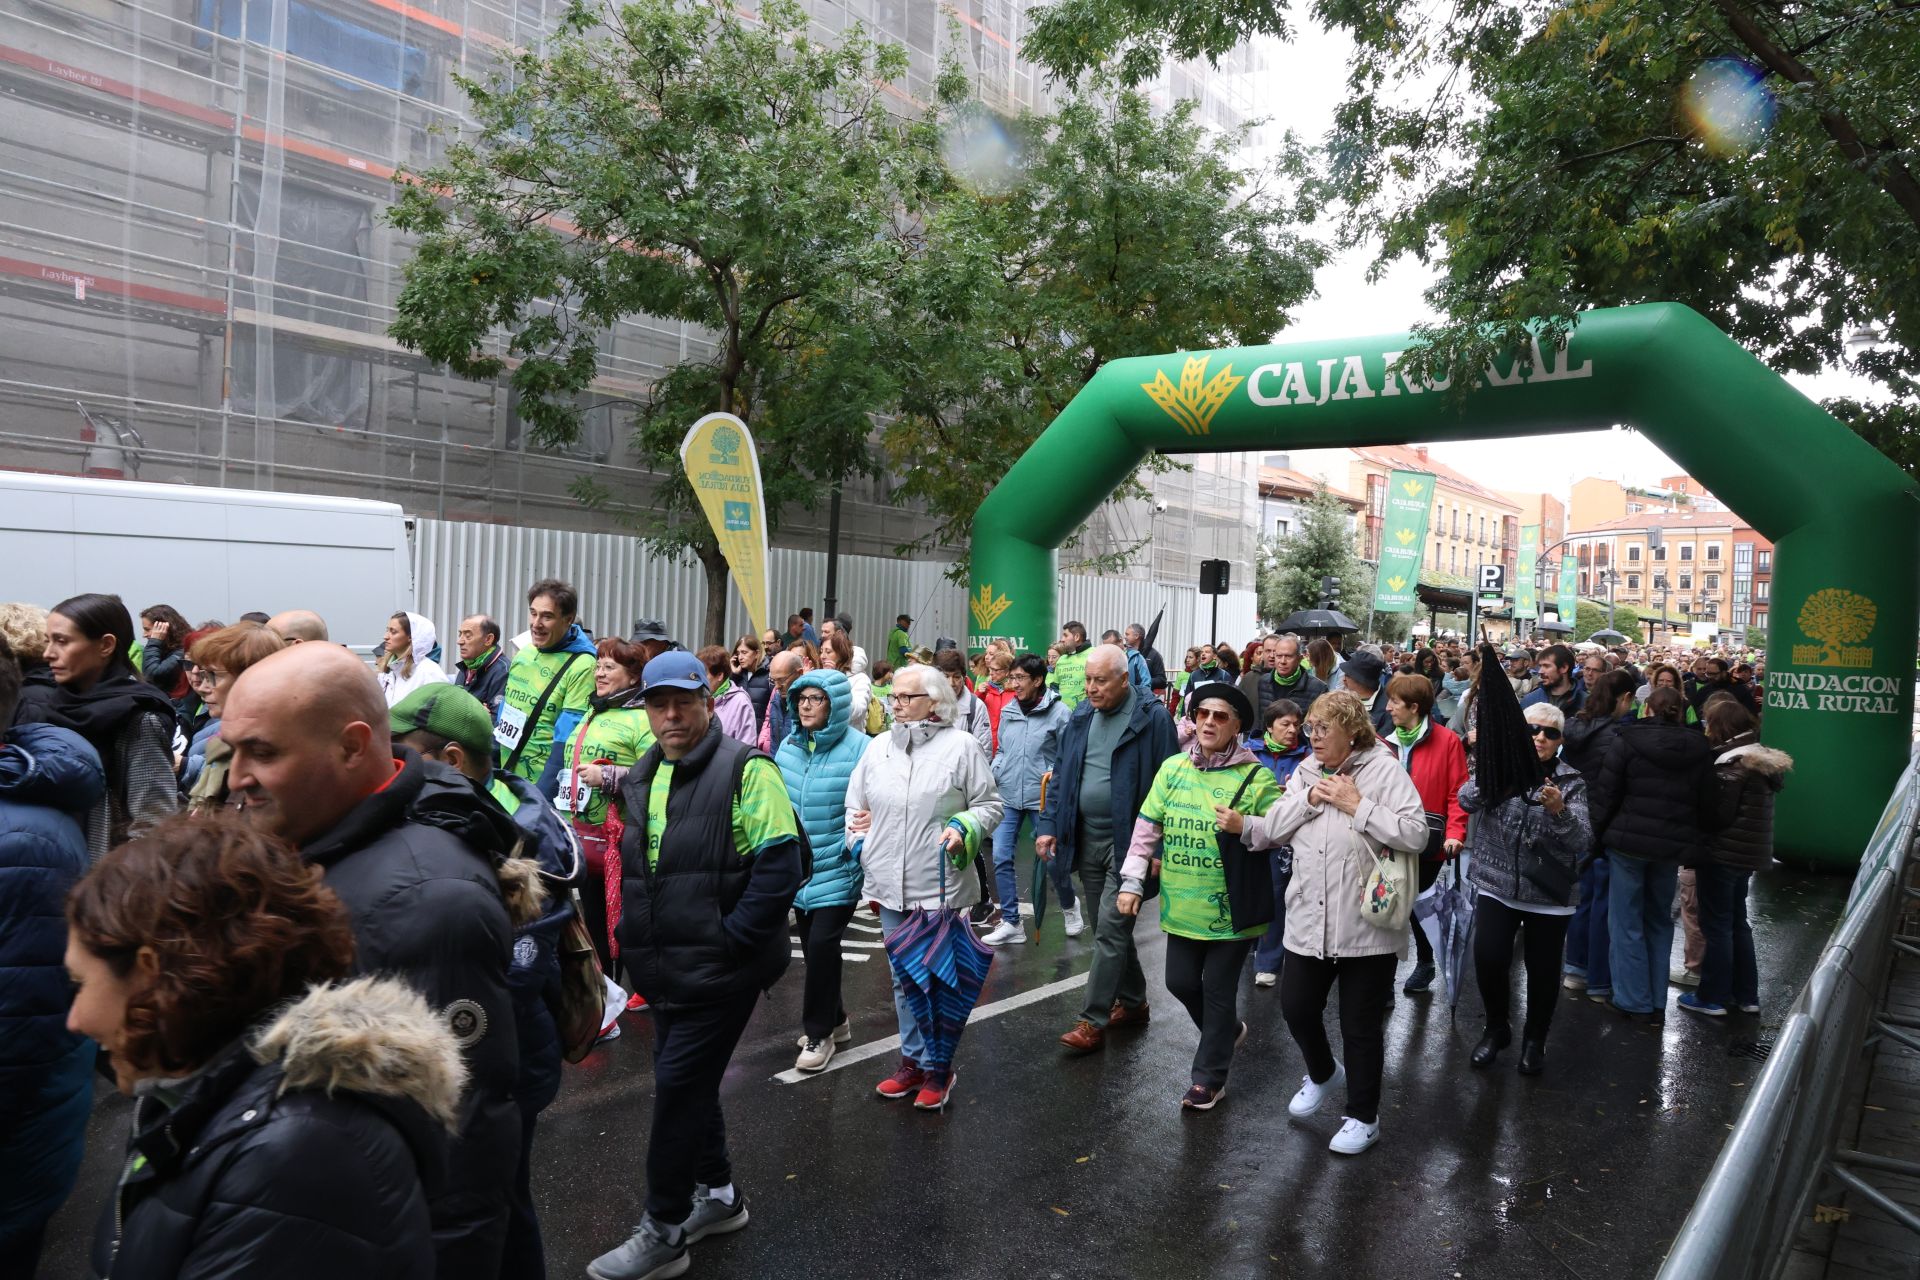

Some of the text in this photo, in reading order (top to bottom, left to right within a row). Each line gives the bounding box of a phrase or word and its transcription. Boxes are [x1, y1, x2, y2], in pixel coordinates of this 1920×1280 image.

[48, 62, 87, 81] Layher
[42, 267, 80, 282] Layhe
[1247, 355, 1376, 406] CAJA
[1481, 566, 1501, 587] P
[978, 636, 1029, 650] RUAL
[1062, 665, 1085, 673] march
[1768, 671, 1902, 696] FUNDACION
[510, 688, 557, 713] marca
[1767, 690, 1899, 714] CAJA RURAL
[1179, 816, 1222, 833] marc
[1171, 851, 1224, 869] cánce
